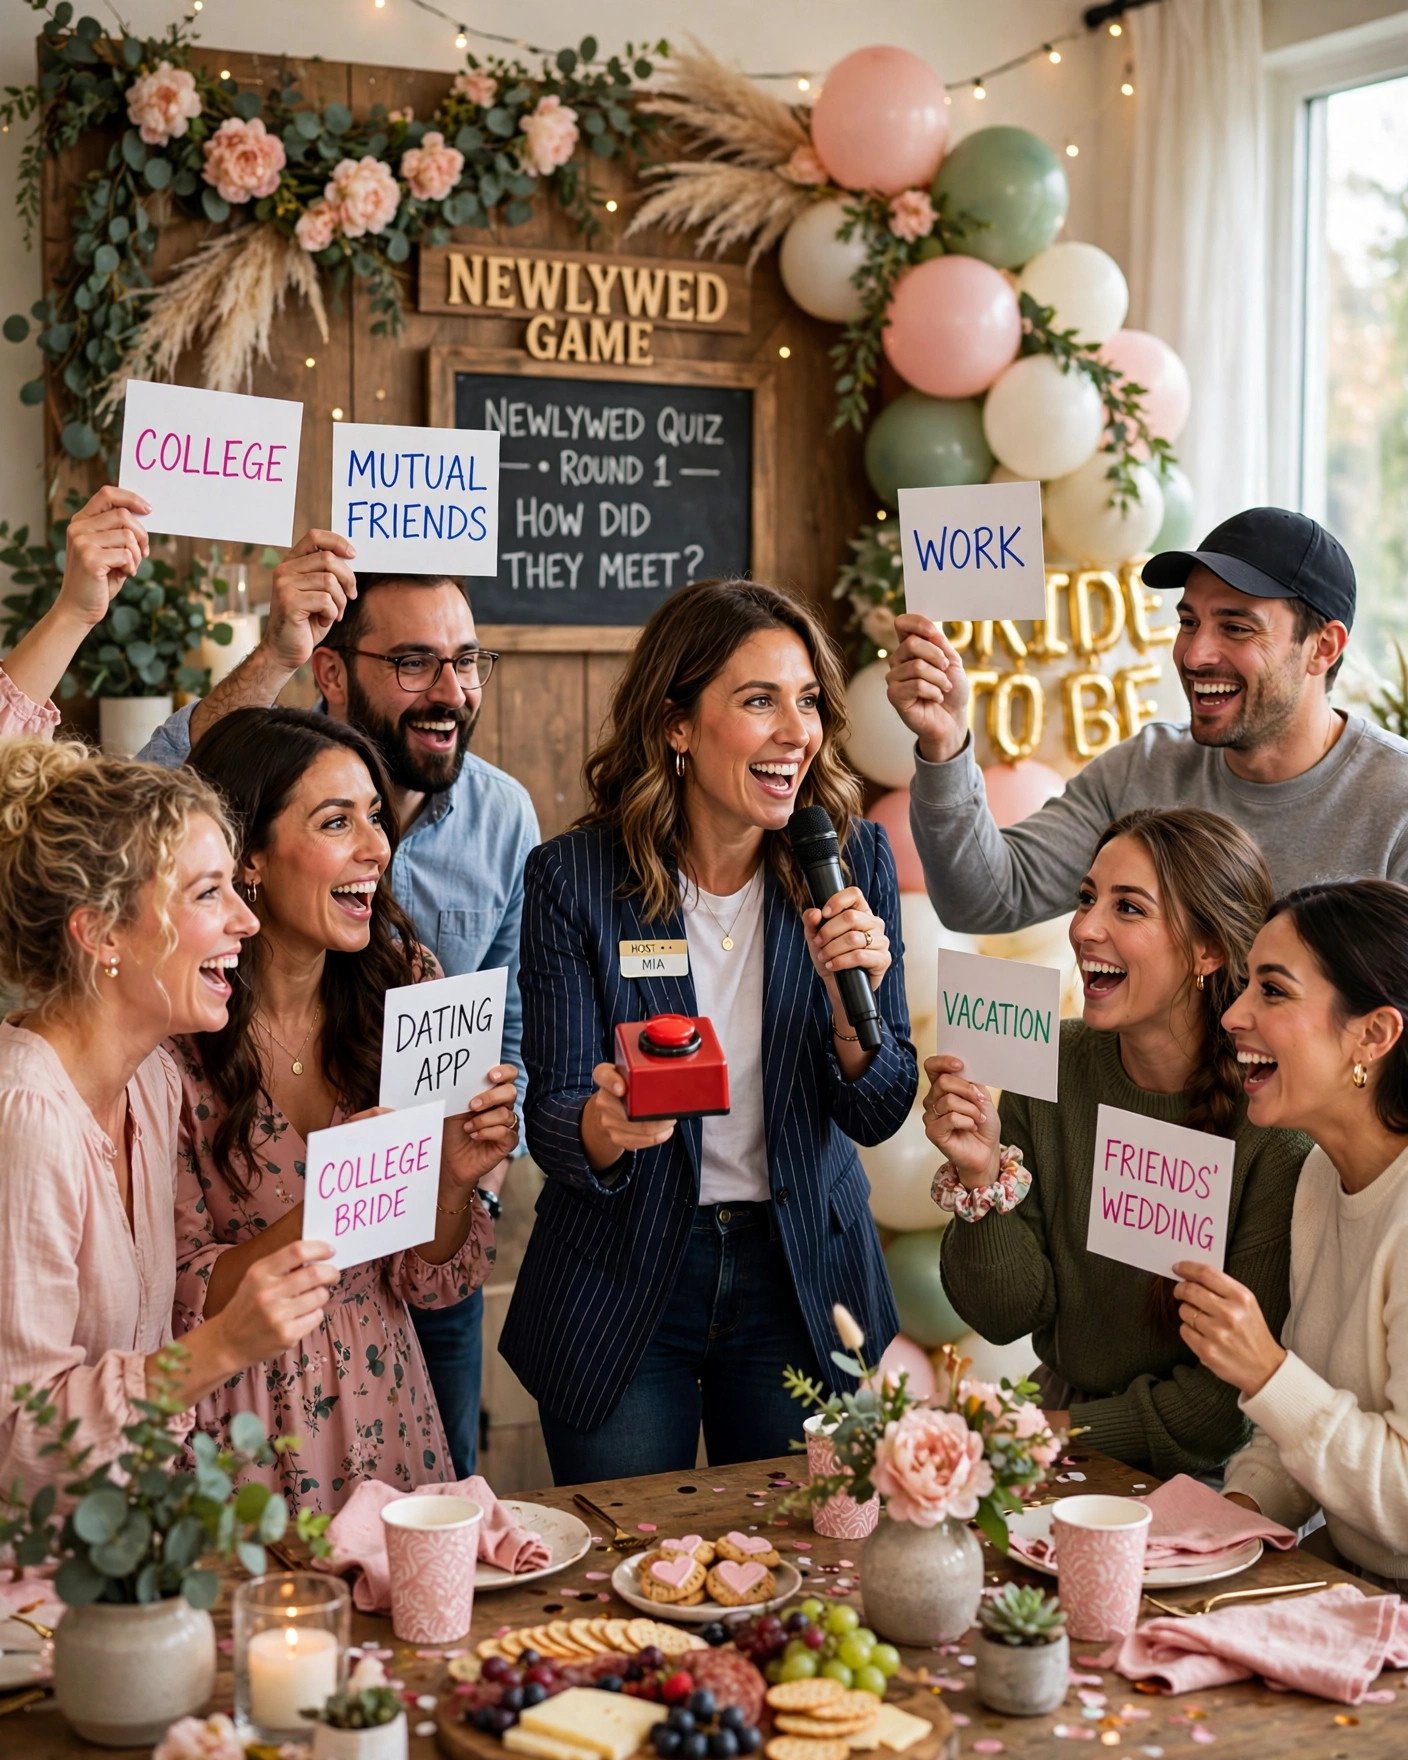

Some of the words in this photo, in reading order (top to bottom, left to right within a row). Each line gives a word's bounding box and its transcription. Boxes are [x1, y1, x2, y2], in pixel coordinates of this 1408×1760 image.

[447, 252, 729, 324] NEWLYWED
[525, 314, 654, 366] GAME
[485, 396, 645, 441] NEWLYWED
[656, 406, 724, 447] QUIZ
[136, 429, 286, 482] COLLEGE
[348, 450, 487, 491] MUTUAL
[560, 449, 643, 487] ROUND
[652, 453, 672, 487] 1
[347, 501, 487, 542] FRIENDS
[516, 497, 584, 538] HOW
[599, 501, 651, 537] DID
[501, 551, 584, 589] THEY
[599, 544, 704, 589] MEET?
[914, 527, 1025, 572] WORK
[631, 943, 655, 953] HOST
[642, 958, 665, 970] MIA
[396, 998, 493, 1053] DATING
[942, 990, 1053, 1045] VACATION
[414, 1049, 470, 1096] APP
[319, 1137, 431, 1200] COLLEGE
[1104, 1138, 1220, 1200] FRIENDS'
[335, 1187, 406, 1236] BRIDE
[1102, 1186, 1215, 1252] WEDDING
